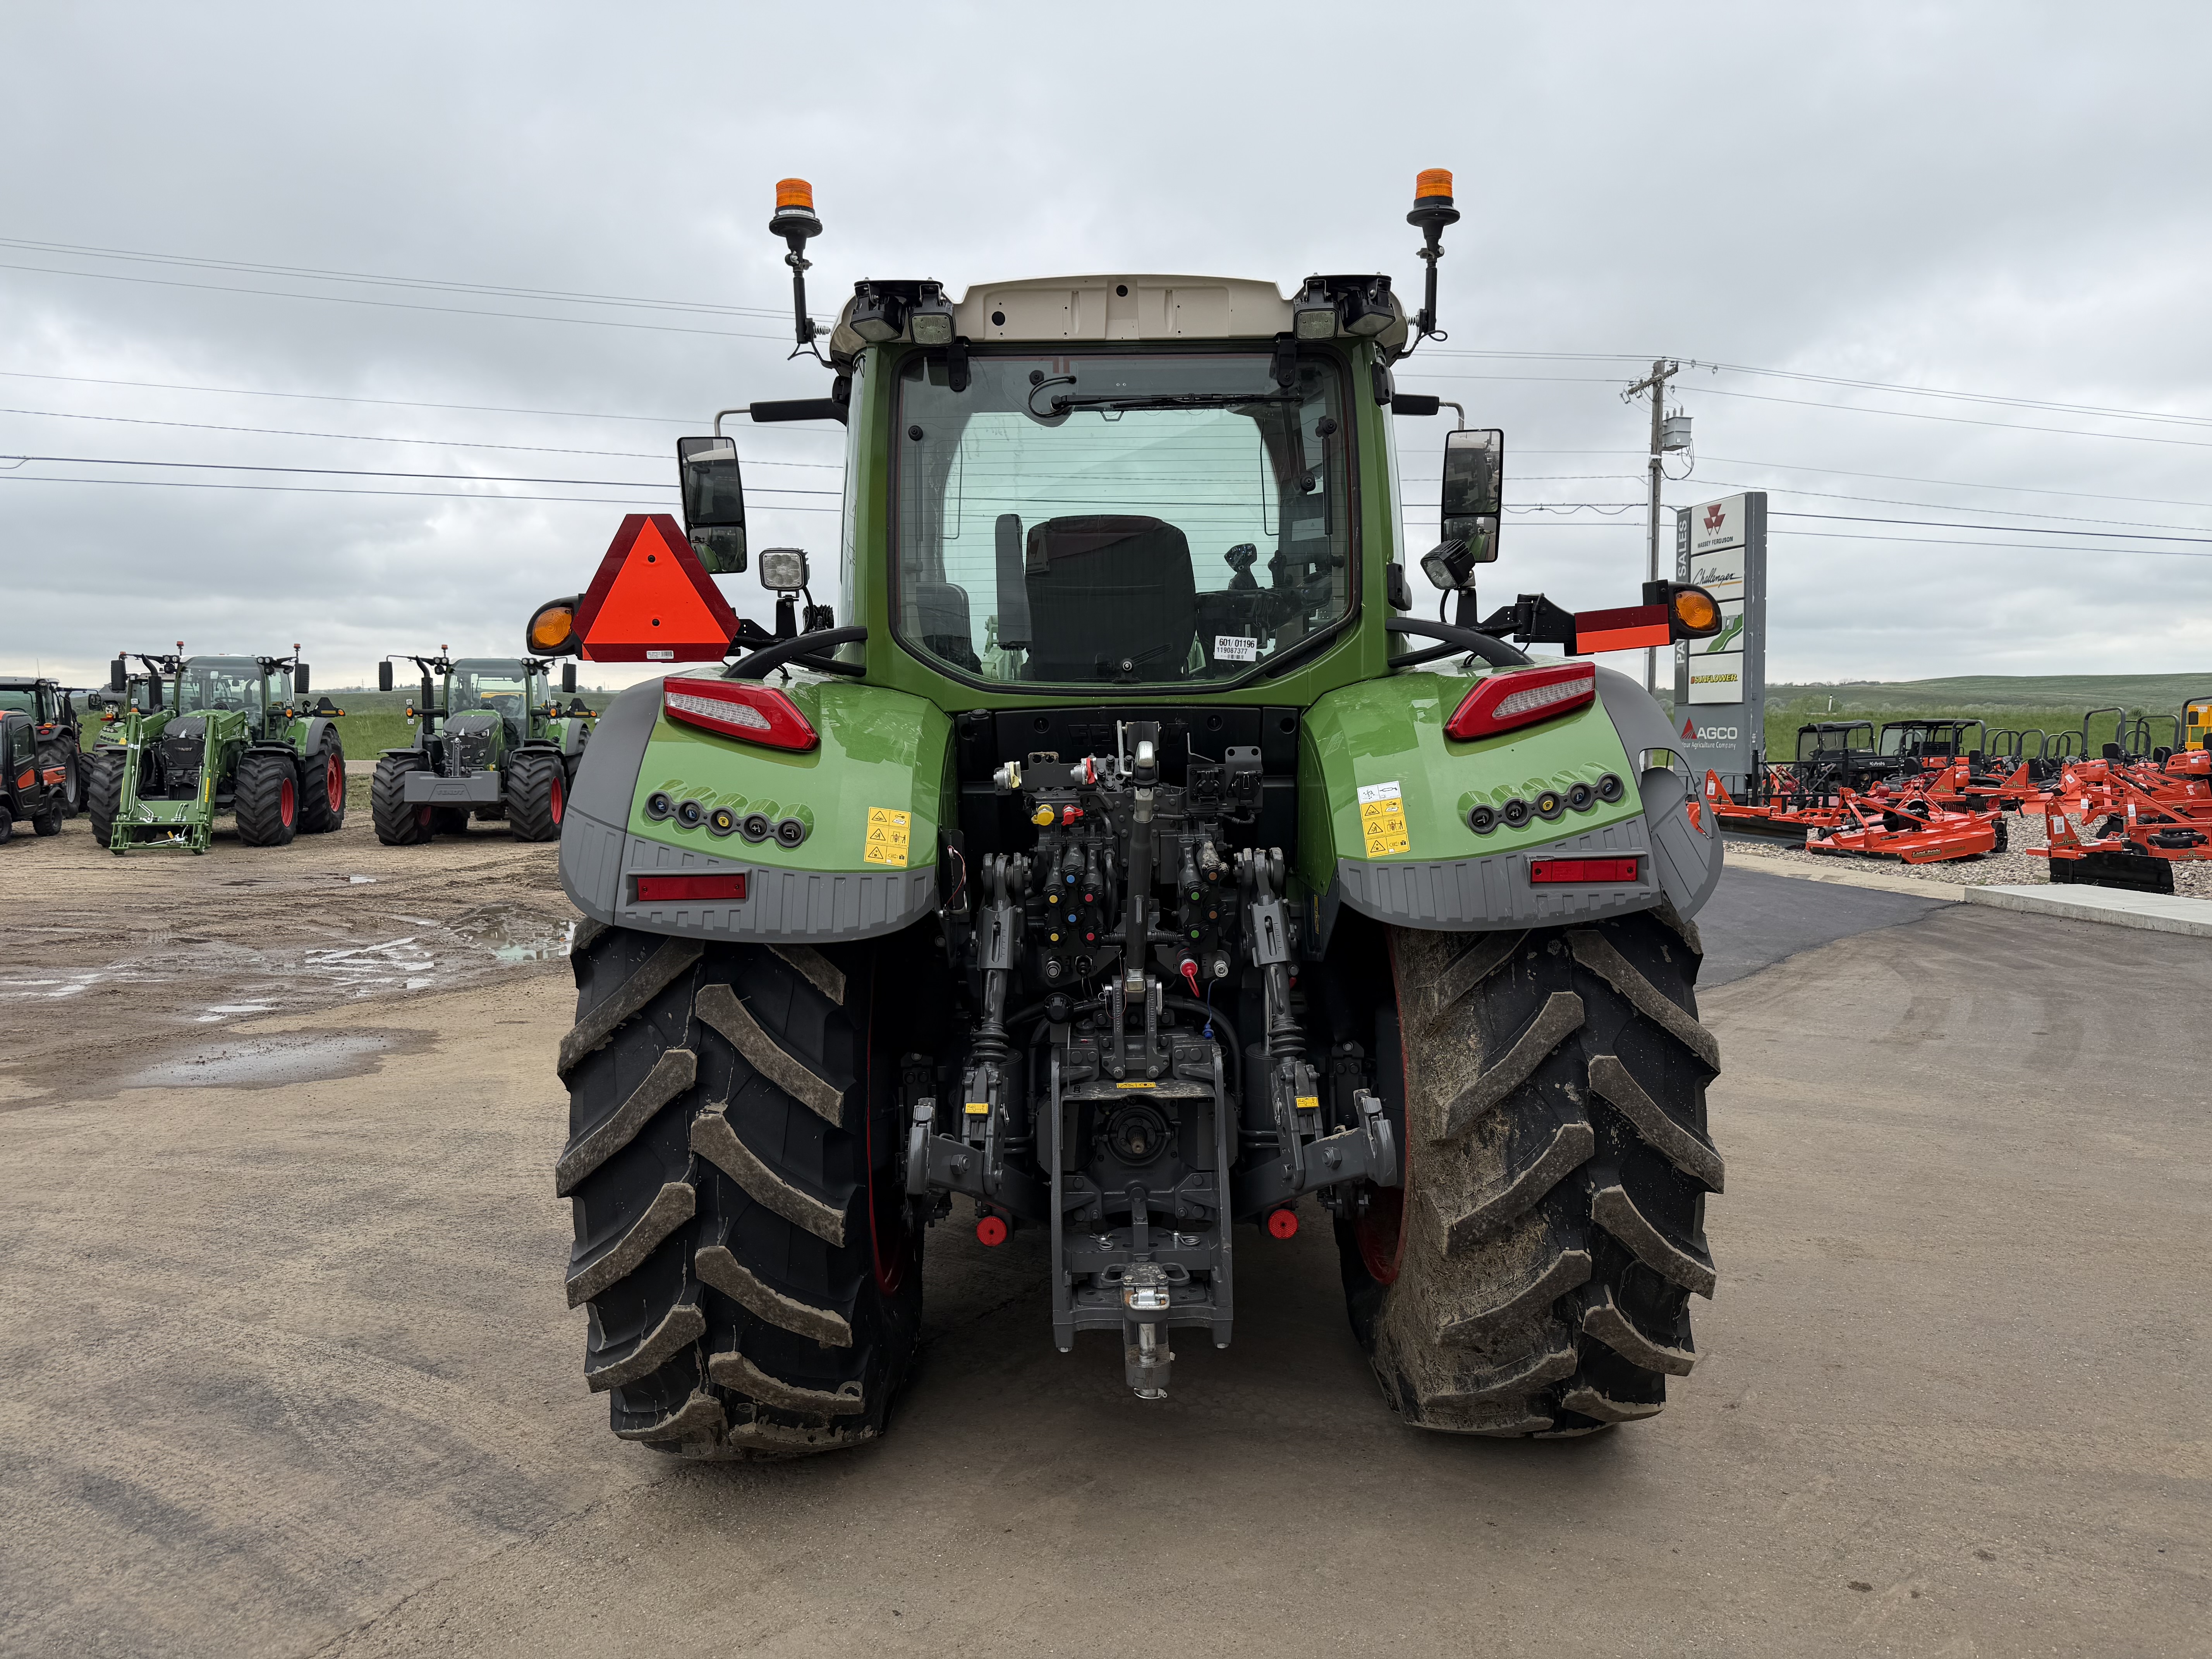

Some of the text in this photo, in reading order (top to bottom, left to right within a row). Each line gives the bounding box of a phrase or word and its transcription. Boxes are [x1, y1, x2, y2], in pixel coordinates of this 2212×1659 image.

[1697, 536, 1733, 548] MASSEY FERGUSON
[1692, 567, 1743, 588] Challenger
[1676, 520, 1687, 664] PA SALES
[1697, 727, 1738, 740] AGCO
[1691, 741, 1715, 750] Agriculture
[1716, 742, 1736, 750] Company
